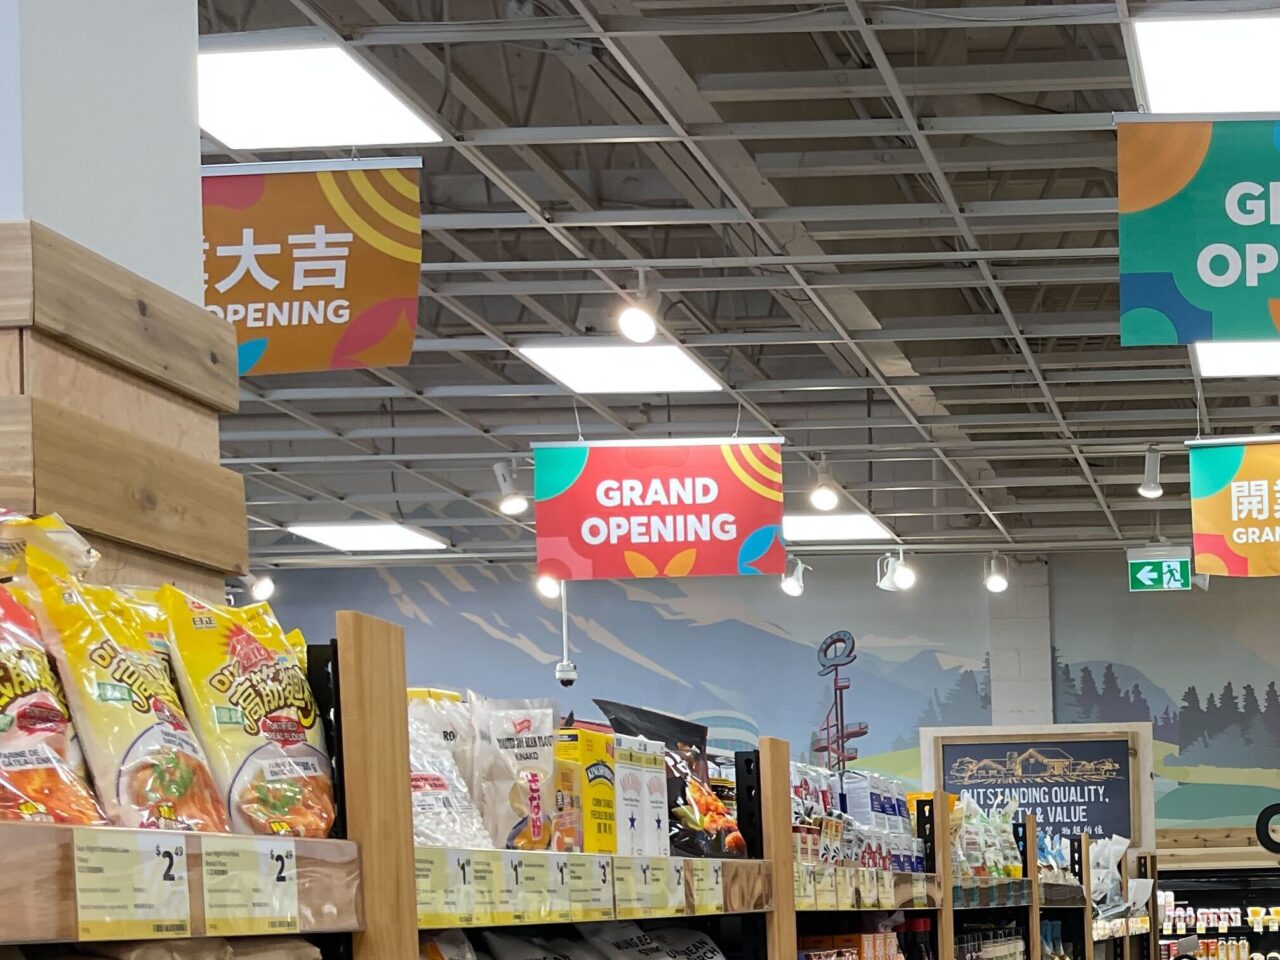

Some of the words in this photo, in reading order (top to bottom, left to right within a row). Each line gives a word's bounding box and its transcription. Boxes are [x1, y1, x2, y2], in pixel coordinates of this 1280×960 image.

[201, 225, 353, 294] 大吉
[596, 477, 718, 507] GRAND
[581, 513, 736, 545] OPENING
[514, 751, 539, 761] KINAKO
[960, 787, 1048, 804] OUTSTANDING
[1052, 785, 1109, 804] QUALITY,
[1036, 808, 1044, 822] &
[1048, 805, 1087, 823] VALUE
